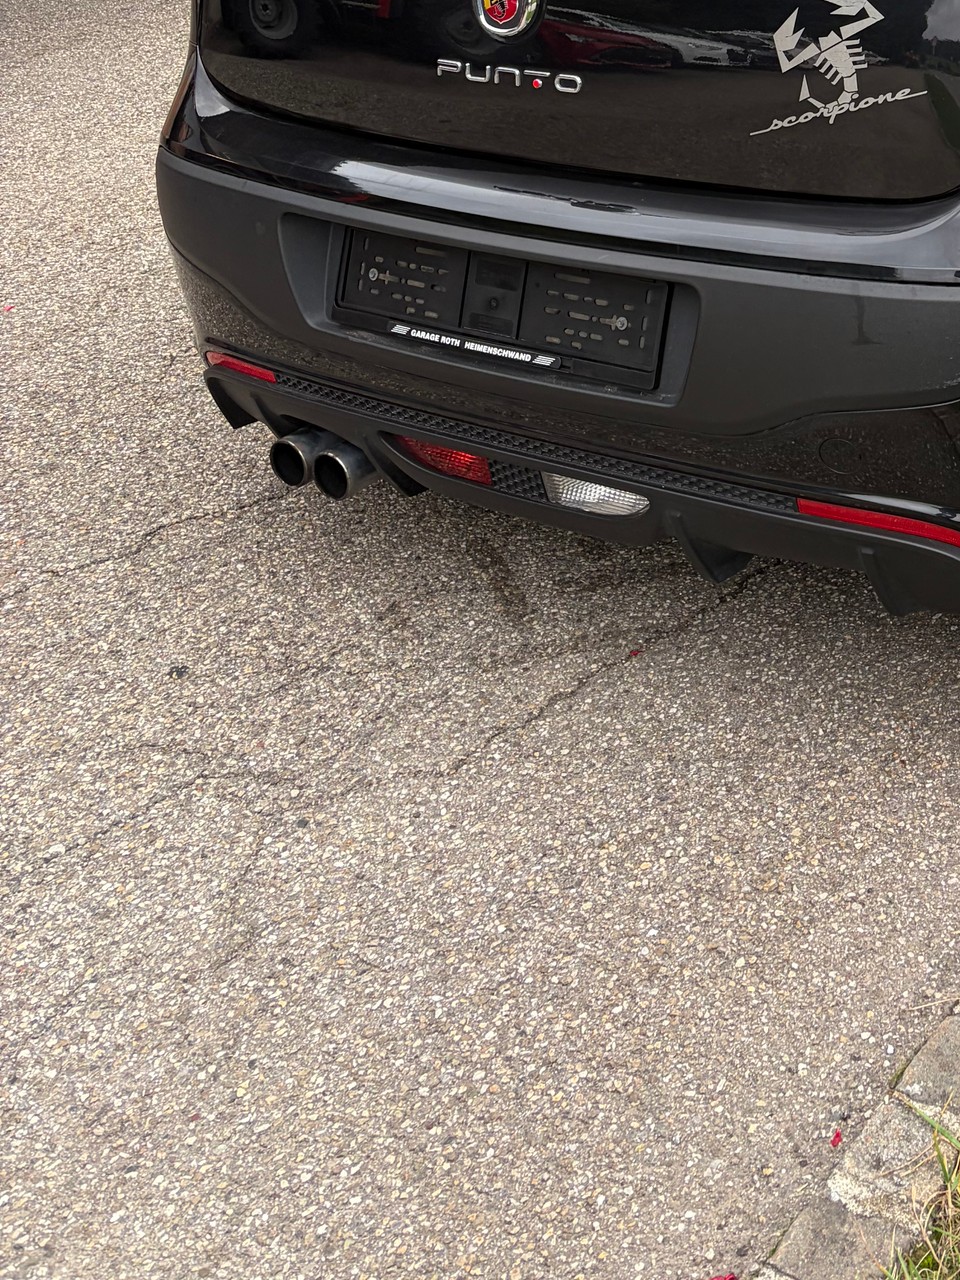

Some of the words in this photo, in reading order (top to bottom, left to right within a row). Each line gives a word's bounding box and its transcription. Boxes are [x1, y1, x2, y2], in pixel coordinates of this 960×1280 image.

[436, 58, 583, 94] PUNTO
[749, 87, 928, 136] scorpione
[410, 329, 440, 342] GARAGE
[440, 335, 461, 348] ROTH
[464, 341, 532, 363] HEIMENSCHWAND
